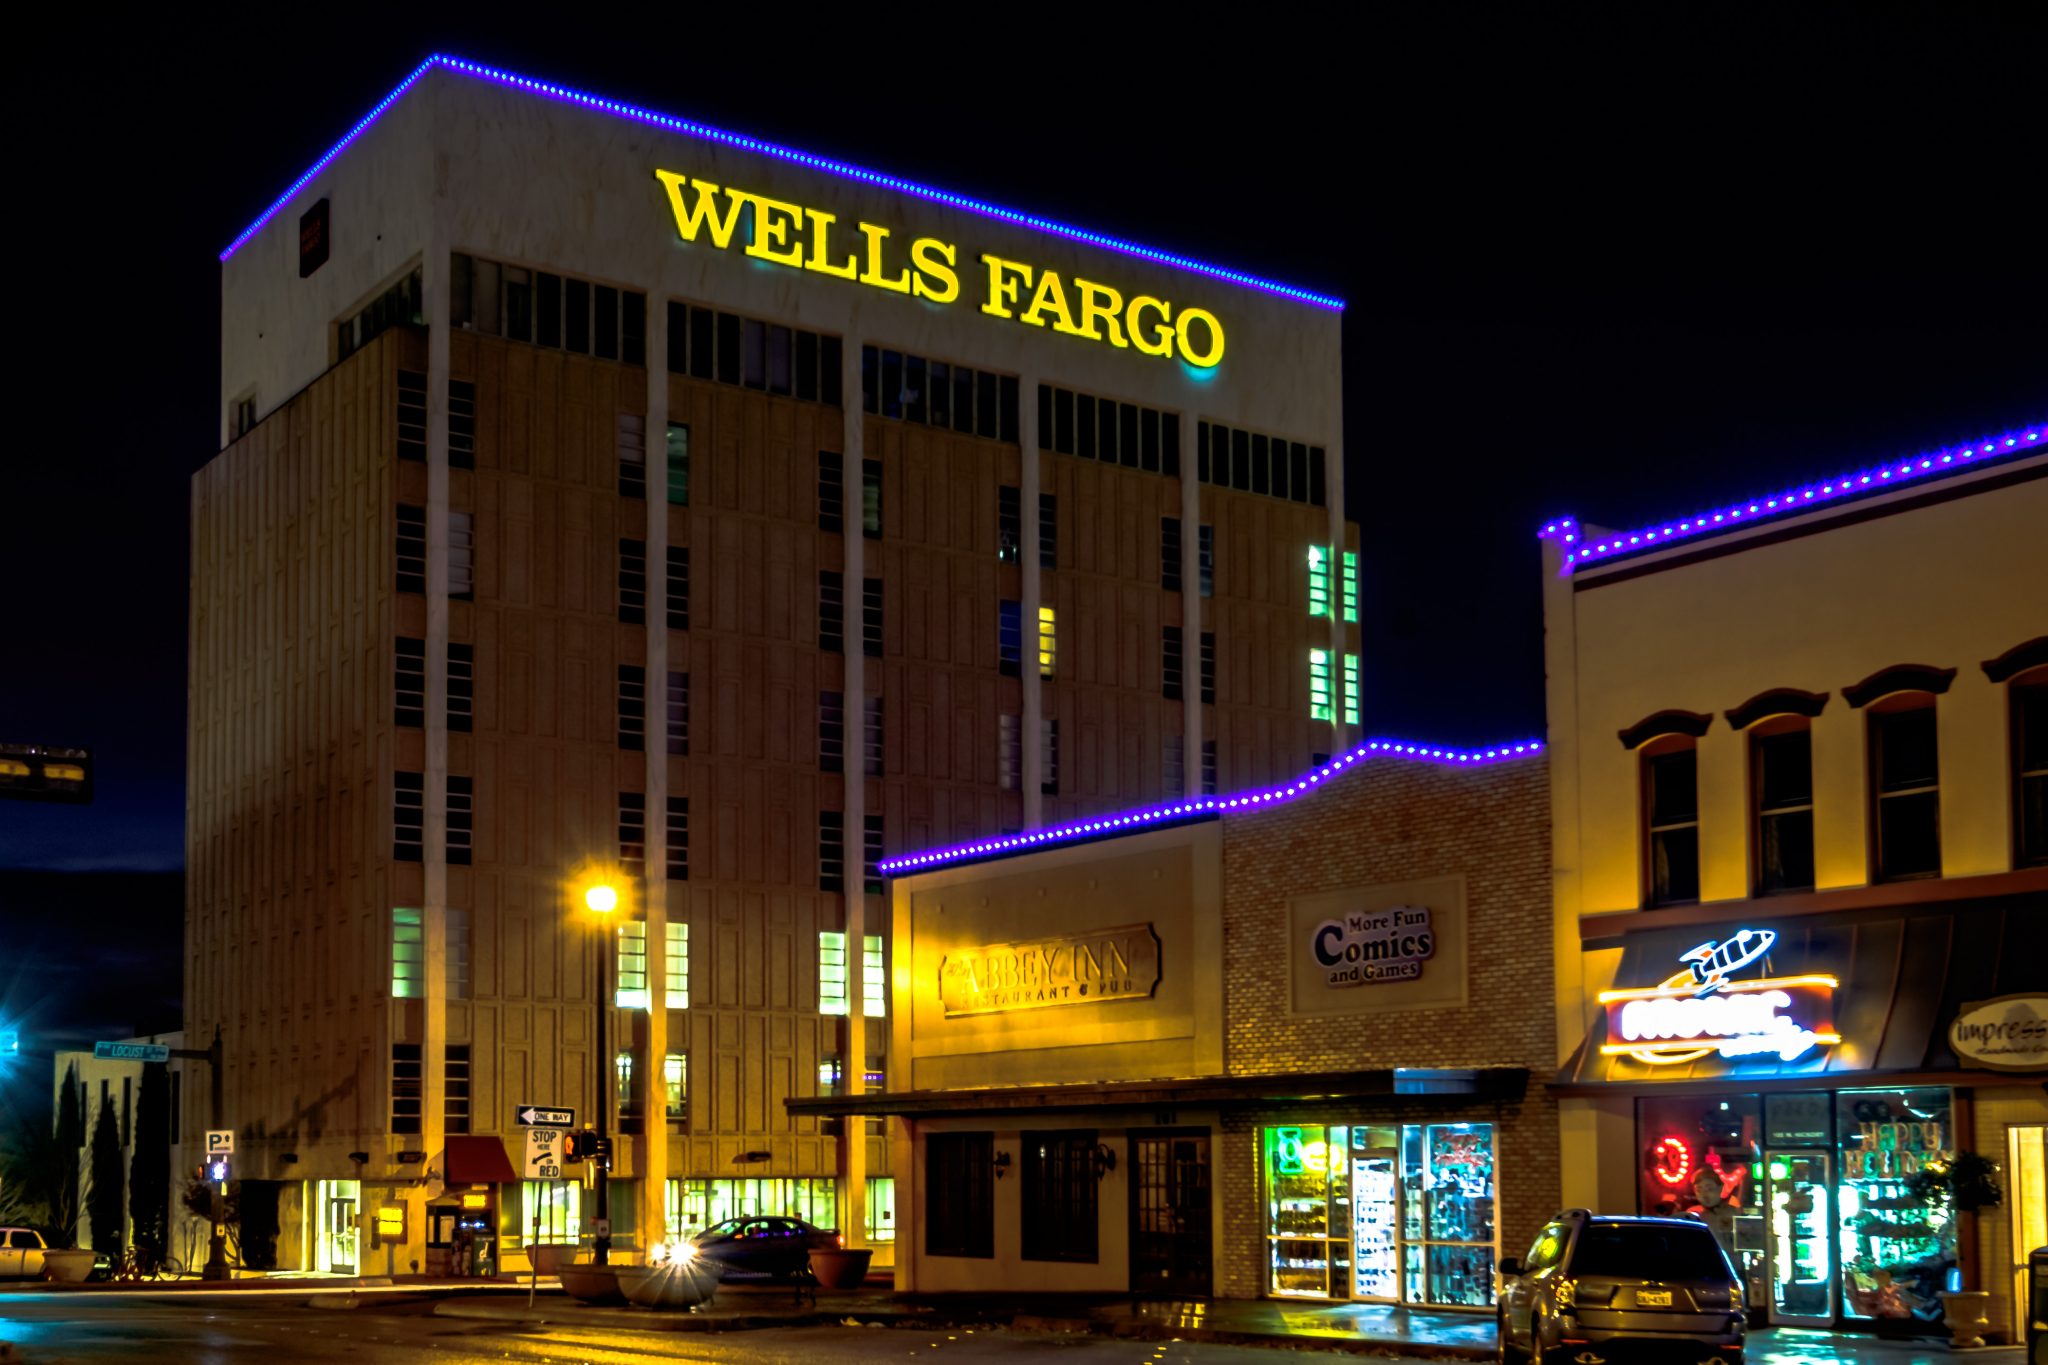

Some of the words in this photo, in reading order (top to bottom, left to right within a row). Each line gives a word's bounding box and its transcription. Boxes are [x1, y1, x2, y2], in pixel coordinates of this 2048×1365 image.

[655, 168, 960, 304] WELLS
[981, 253, 1225, 369] FARGO
[1348, 917, 1389, 933] More
[1393, 910, 1426, 927] Fun
[1315, 925, 1431, 967] Comics
[961, 947, 1060, 994] ABBEY
[1072, 938, 1132, 981] INN
[1329, 966, 1359, 984] and
[1363, 962, 1417, 980] Games
[112, 1045, 145, 1058] LOCUST
[534, 1112, 550, 1121] ONE
[552, 1113, 569, 1121] WAY
[209, 1134, 223, 1152] P
[532, 1131, 557, 1143] STOP
[539, 1165, 559, 1177] RED
